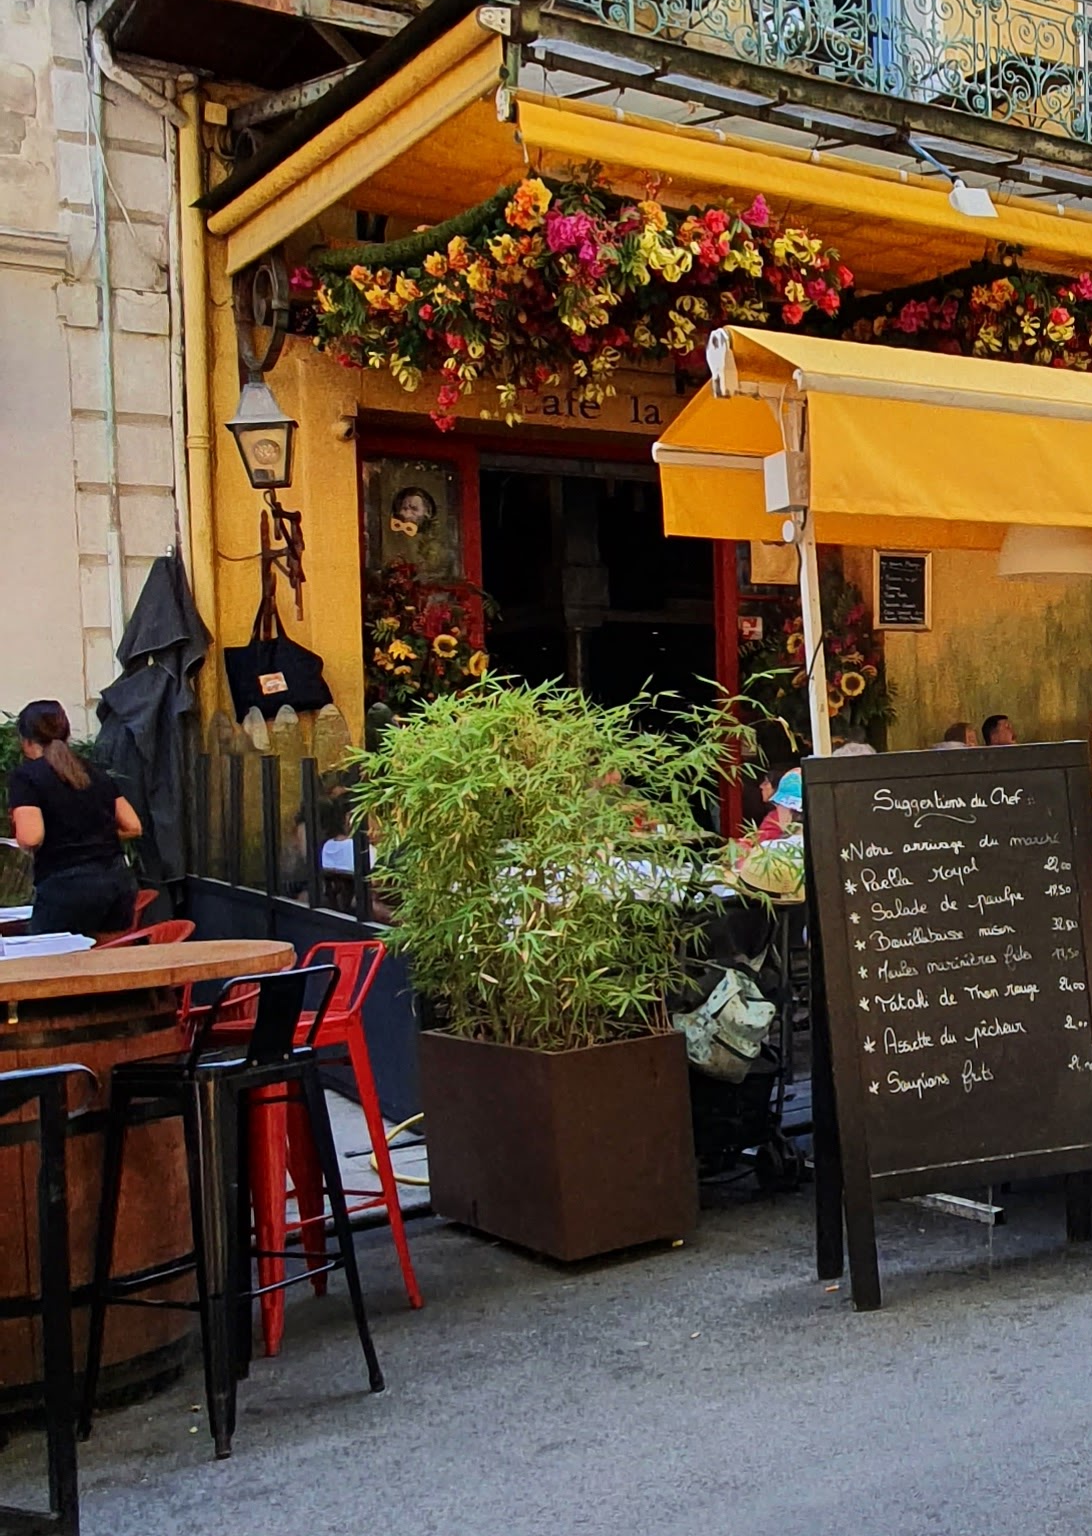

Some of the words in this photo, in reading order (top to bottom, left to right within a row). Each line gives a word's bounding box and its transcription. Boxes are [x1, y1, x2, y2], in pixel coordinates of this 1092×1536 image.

[630, 395, 664, 425] la
[873, 789, 966, 817] Suggestions
[970, 792, 988, 809] du
[990, 787, 1023, 806] Chef
[850, 840, 893, 861] Notre
[903, 838, 965, 855] arrivage
[979, 834, 999, 848] du
[861, 867, 913, 893] Paella
[928, 857, 980, 886] royal
[871, 899, 928, 922] Salade
[940, 894, 959, 912] de
[875, 989, 930, 1013] Tataki
[939, 987, 958, 1007] de
[964, 984, 999, 1000] Thon
[1003, 983, 1040, 1002] rouge
[940, 1026, 957, 1046] du
[964, 1016, 1027, 1049] pêcheur
